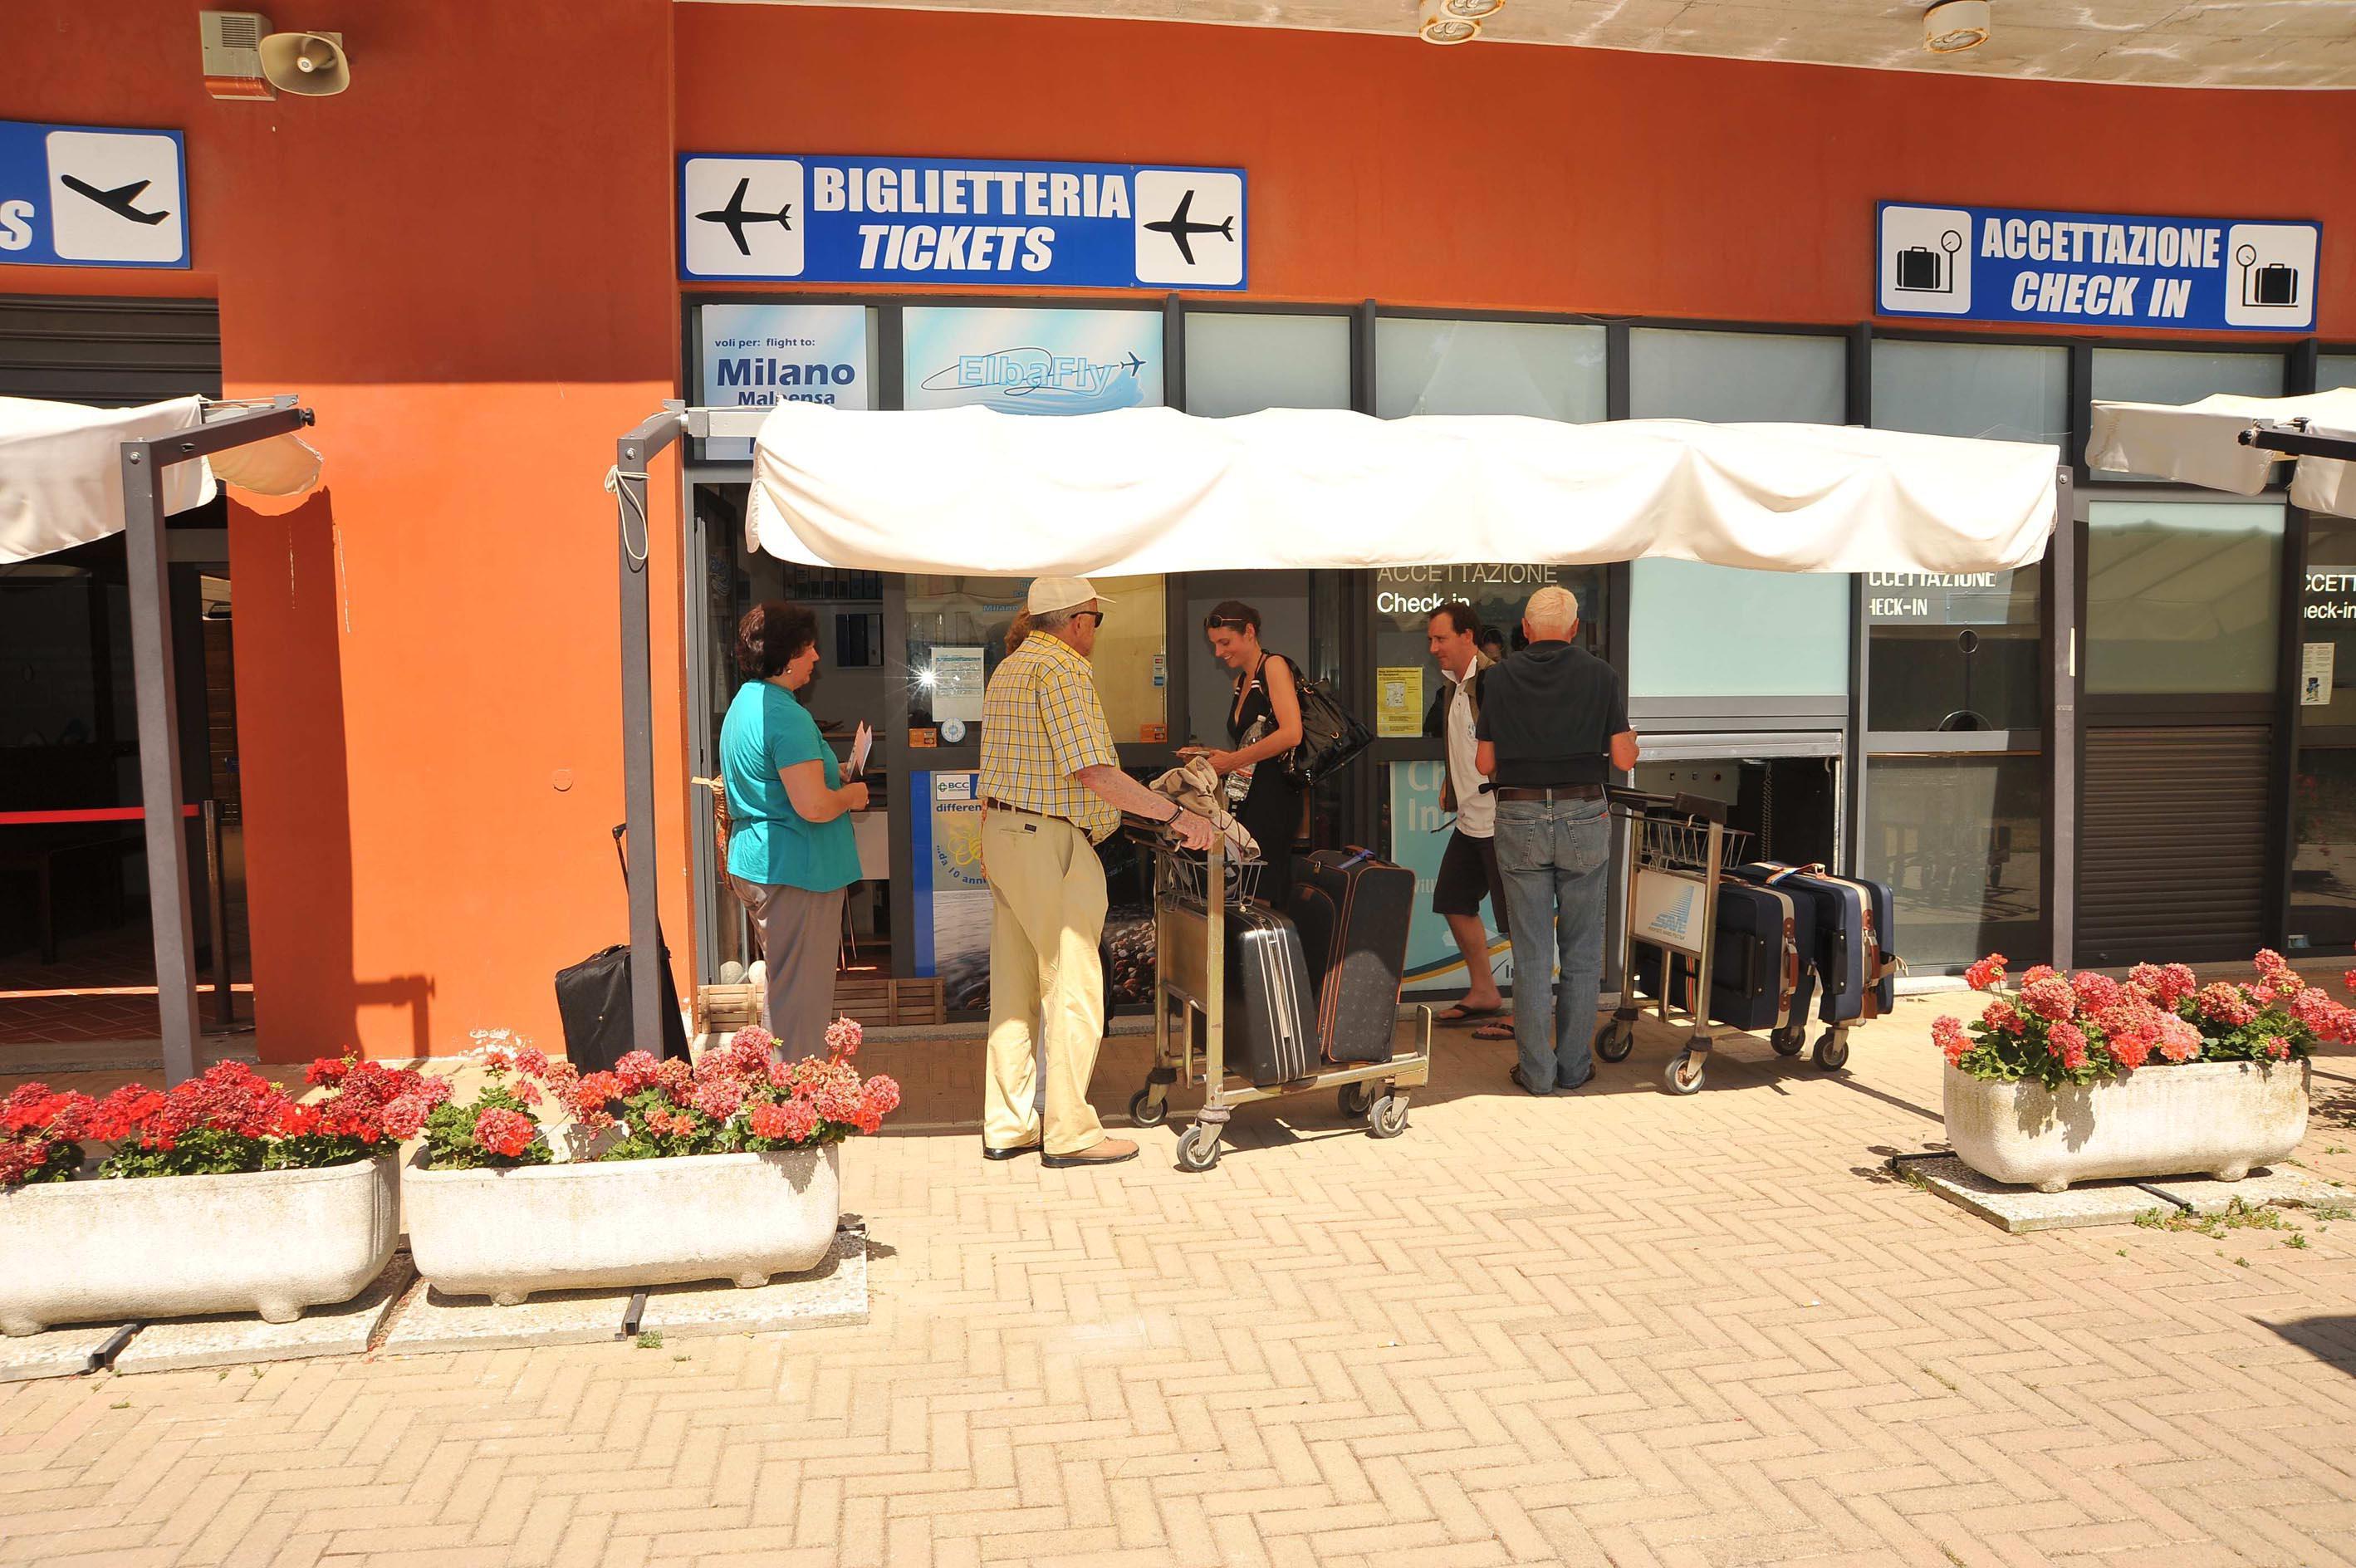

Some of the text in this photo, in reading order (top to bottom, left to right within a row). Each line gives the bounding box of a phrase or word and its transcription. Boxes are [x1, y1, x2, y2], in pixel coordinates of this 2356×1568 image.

[813, 166, 1132, 218] BIGLIETTERIA
[858, 223, 1056, 272] TICKETS
[1981, 218, 2221, 268] ACCETTAZIONE
[2011, 271, 2192, 319] CHECK IN
[715, 338, 816, 349] voli per: flight to:
[717, 358, 855, 386] Milano
[958, 355, 1113, 397] ElbaFly
